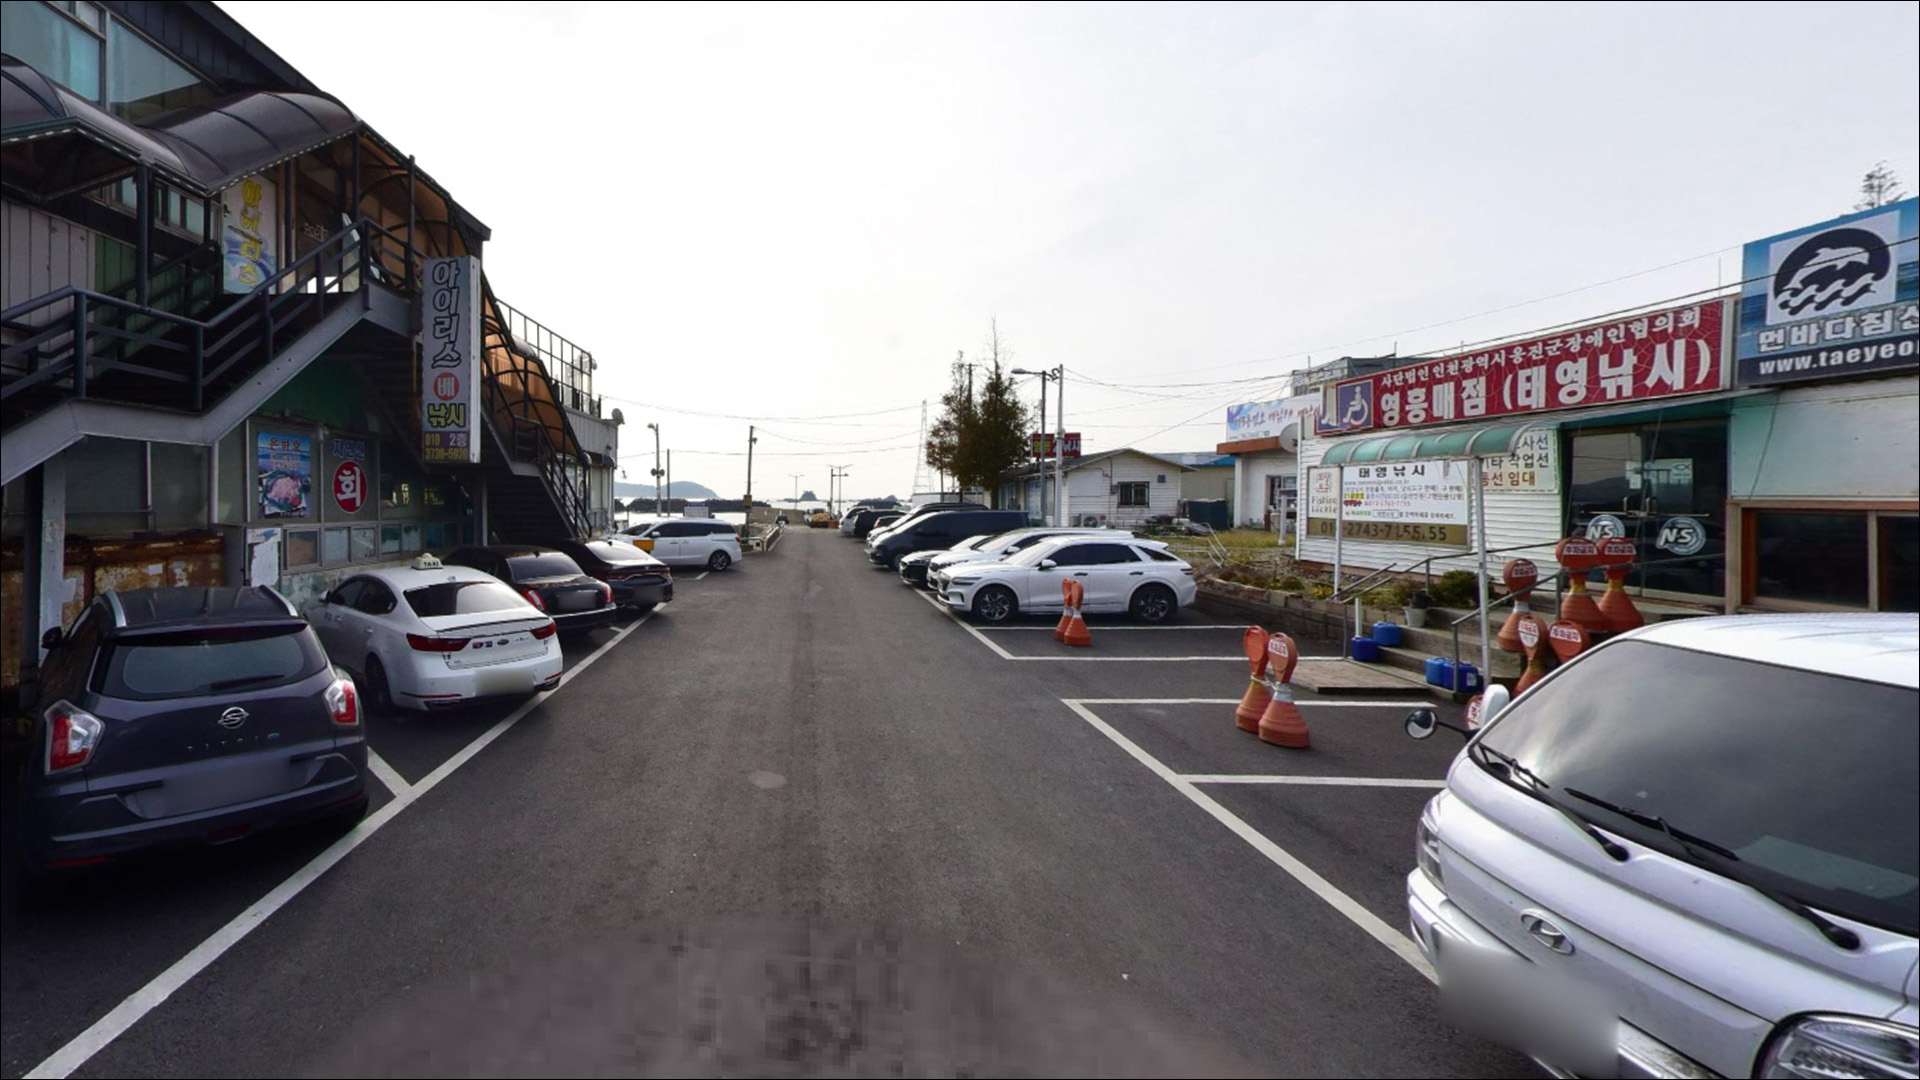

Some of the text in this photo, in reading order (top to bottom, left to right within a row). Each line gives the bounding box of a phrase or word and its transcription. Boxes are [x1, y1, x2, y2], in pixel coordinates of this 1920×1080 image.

[431, 260, 462, 369] 아이리스
[1381, 365, 1429, 388] 사단법인
[1432, 350, 1506, 378] 인천광역시
[1758, 340, 1919, 375] www.taeyeo
[437, 376, 455, 397] 배
[1380, 338, 1711, 427] 영흥매점 (태영낚시)
[427, 403, 466, 428] 낚시
[425, 432, 467, 447] 010 2층
[337, 465, 361, 508] 회
[1358, 465, 1426, 478] 태영낚시
[1508, 471, 1536, 487] 임대
